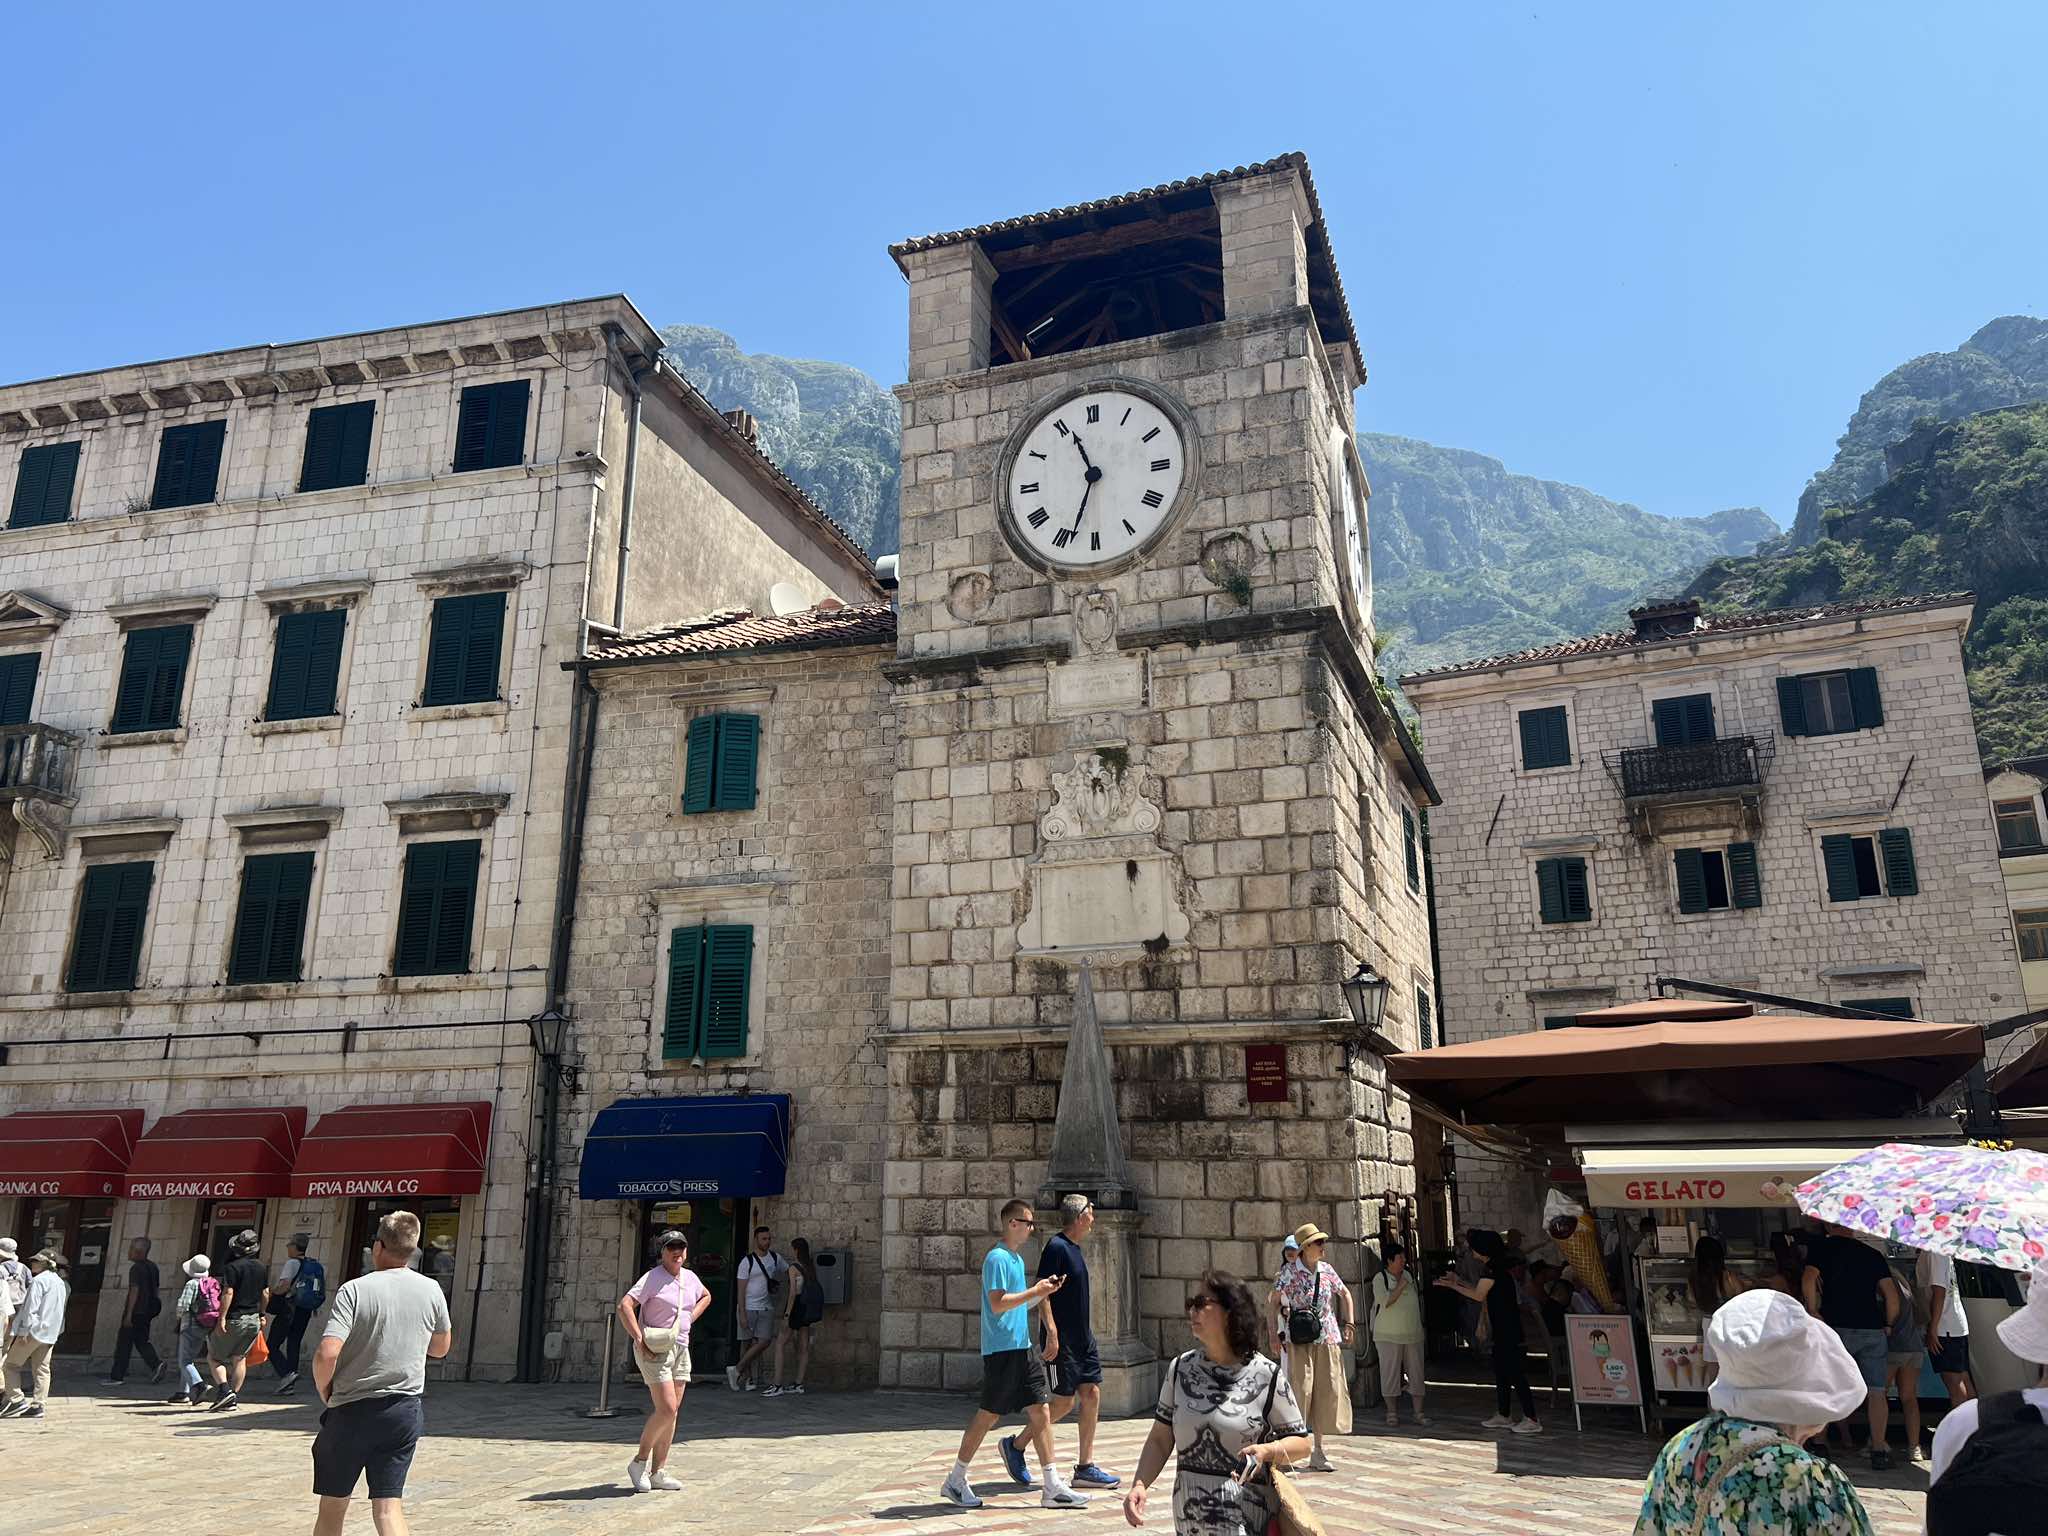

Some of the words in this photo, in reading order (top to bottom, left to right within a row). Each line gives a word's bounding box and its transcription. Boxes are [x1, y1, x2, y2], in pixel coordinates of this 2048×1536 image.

[1086, 404, 1099, 424] XII
[1053, 419, 1070, 438] XI
[1029, 450, 1047, 461] X
[1122, 519, 1136, 535] V
[1091, 532, 1100, 550] VI
[0, 1182, 37, 1194] ANKA
[40, 1182, 60, 1194] CG
[130, 1183, 163, 1196] PRVA
[165, 1183, 210, 1196] BANKA
[213, 1182, 235, 1195] CG
[308, 1182, 342, 1195] PRVA
[345, 1180, 393, 1194] BANKA
[397, 1179, 419, 1193] CG
[618, 1183, 668, 1193] TOBACCO
[683, 1182, 719, 1192] PRESS
[1625, 1180, 1725, 1200] GELATO
